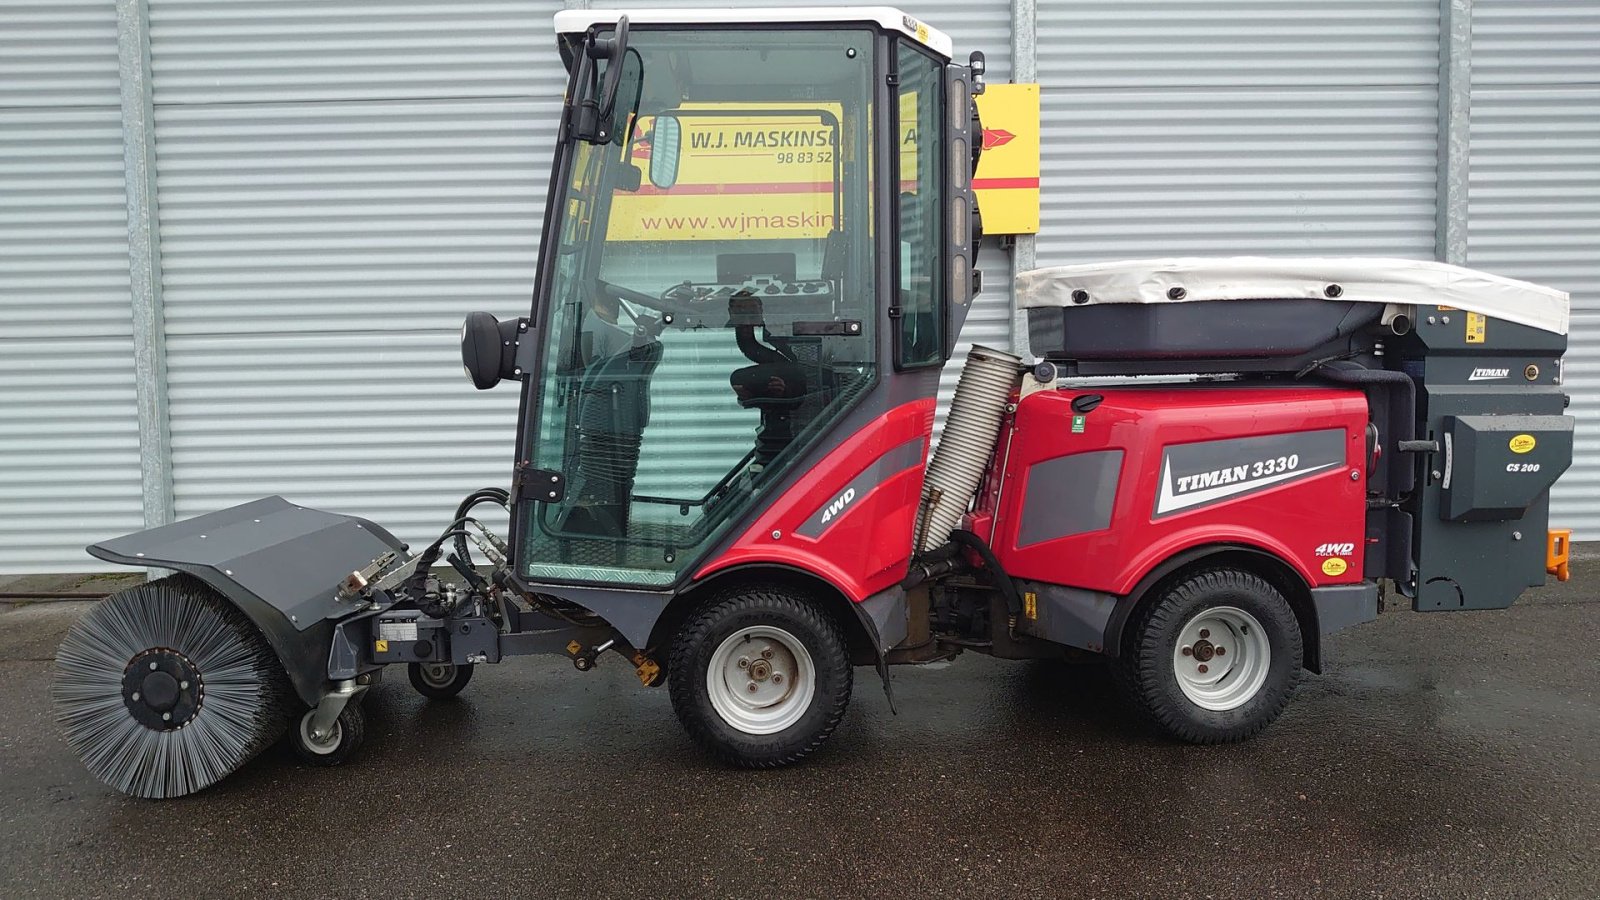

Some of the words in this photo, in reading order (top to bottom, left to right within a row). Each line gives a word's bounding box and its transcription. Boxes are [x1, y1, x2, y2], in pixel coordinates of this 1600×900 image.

[691, 131, 728, 149] W.J.
[734, 130, 834, 148] MASKINS
[777, 152, 794, 164] 98
[797, 152, 814, 164] 83
[816, 151, 832, 163] 52
[641, 211, 844, 233] www.wjmaskin
[1476, 368, 1510, 377] TIMAN
[1177, 464, 1249, 493] TIMAN
[1251, 454, 1299, 477] 3330
[1506, 463, 1521, 472] CS
[1520, 463, 1541, 473] 200
[821, 487, 855, 524] 4WD
[1315, 543, 1355, 553] 4WD
